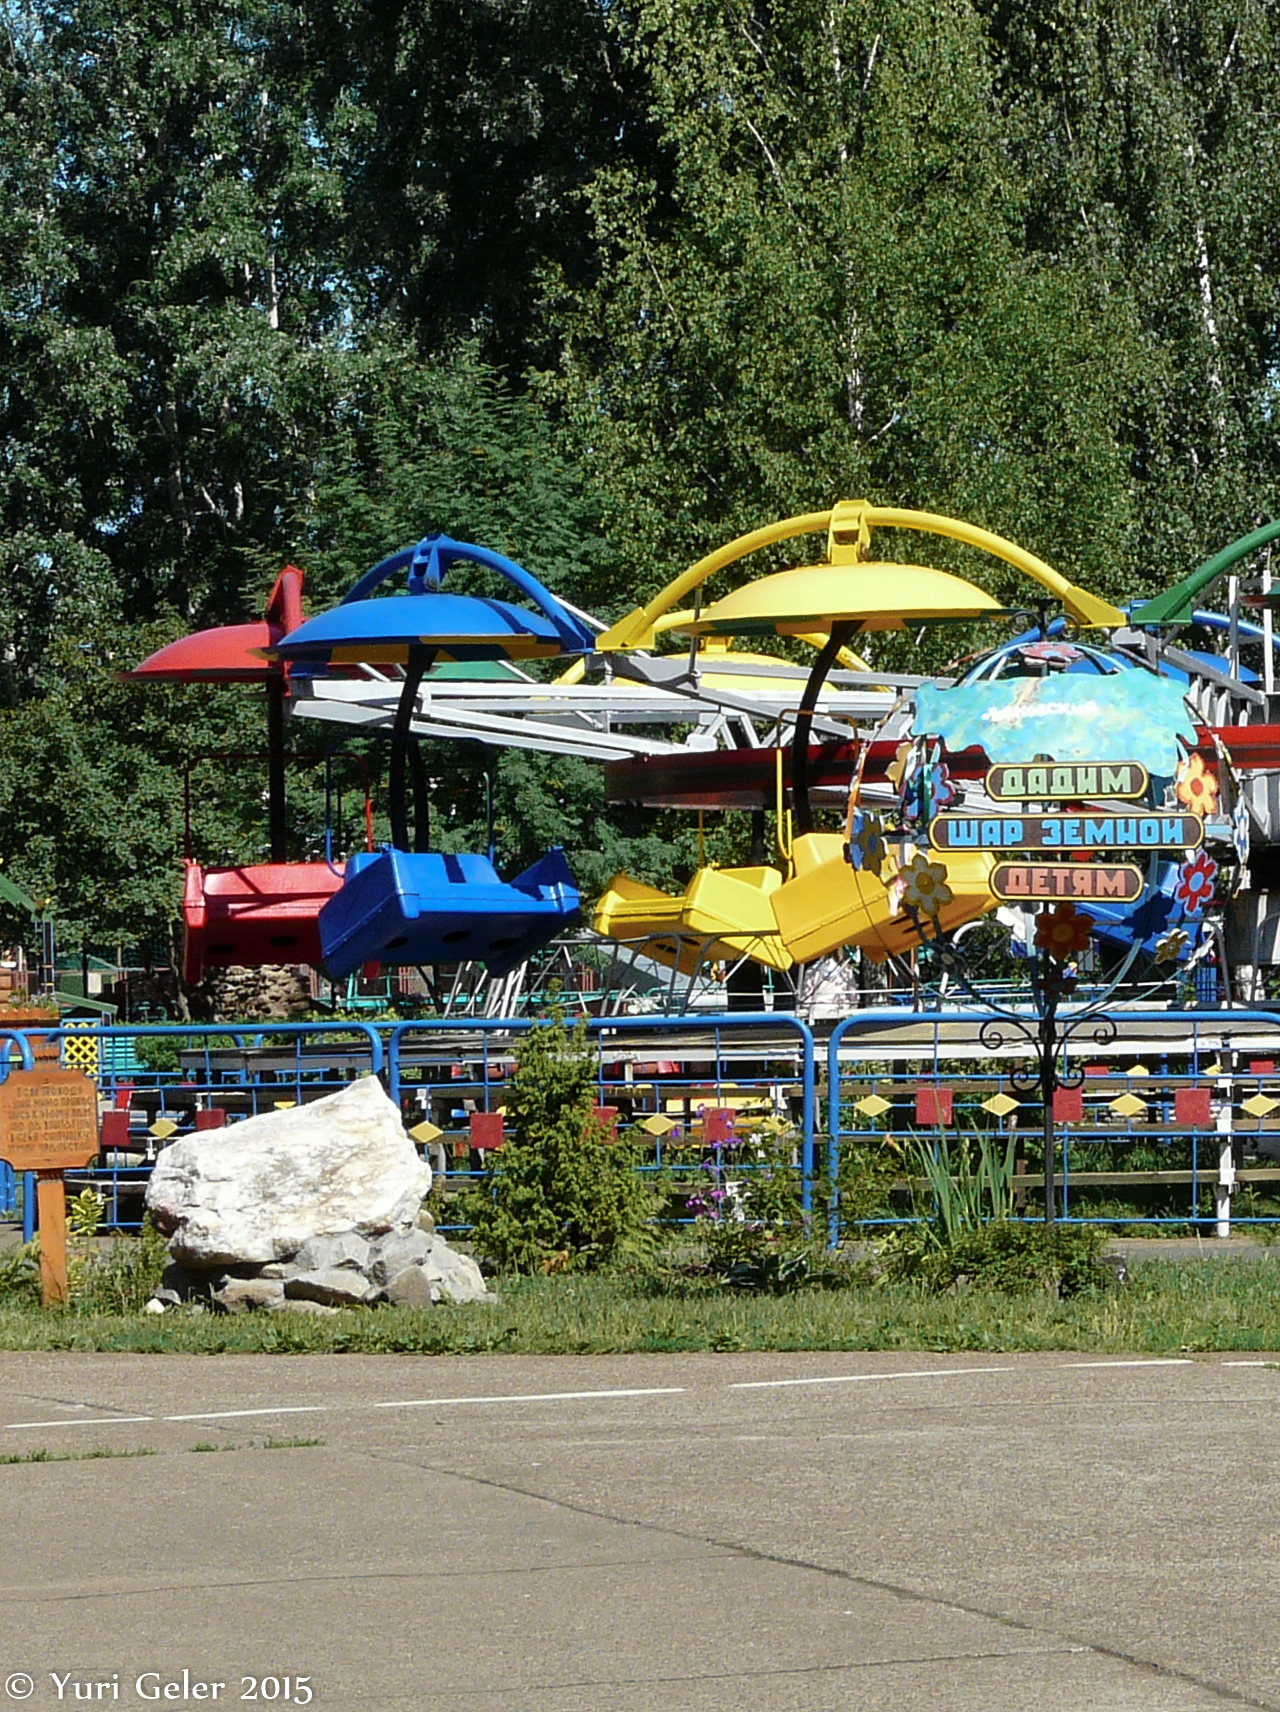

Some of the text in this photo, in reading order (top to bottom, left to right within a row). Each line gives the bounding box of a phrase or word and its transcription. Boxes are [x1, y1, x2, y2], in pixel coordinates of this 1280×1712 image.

[1000, 766, 1131, 796] ДАДИМ
[947, 820, 1024, 847] ШАР
[1004, 867, 1127, 896] ДЕТЯМ
